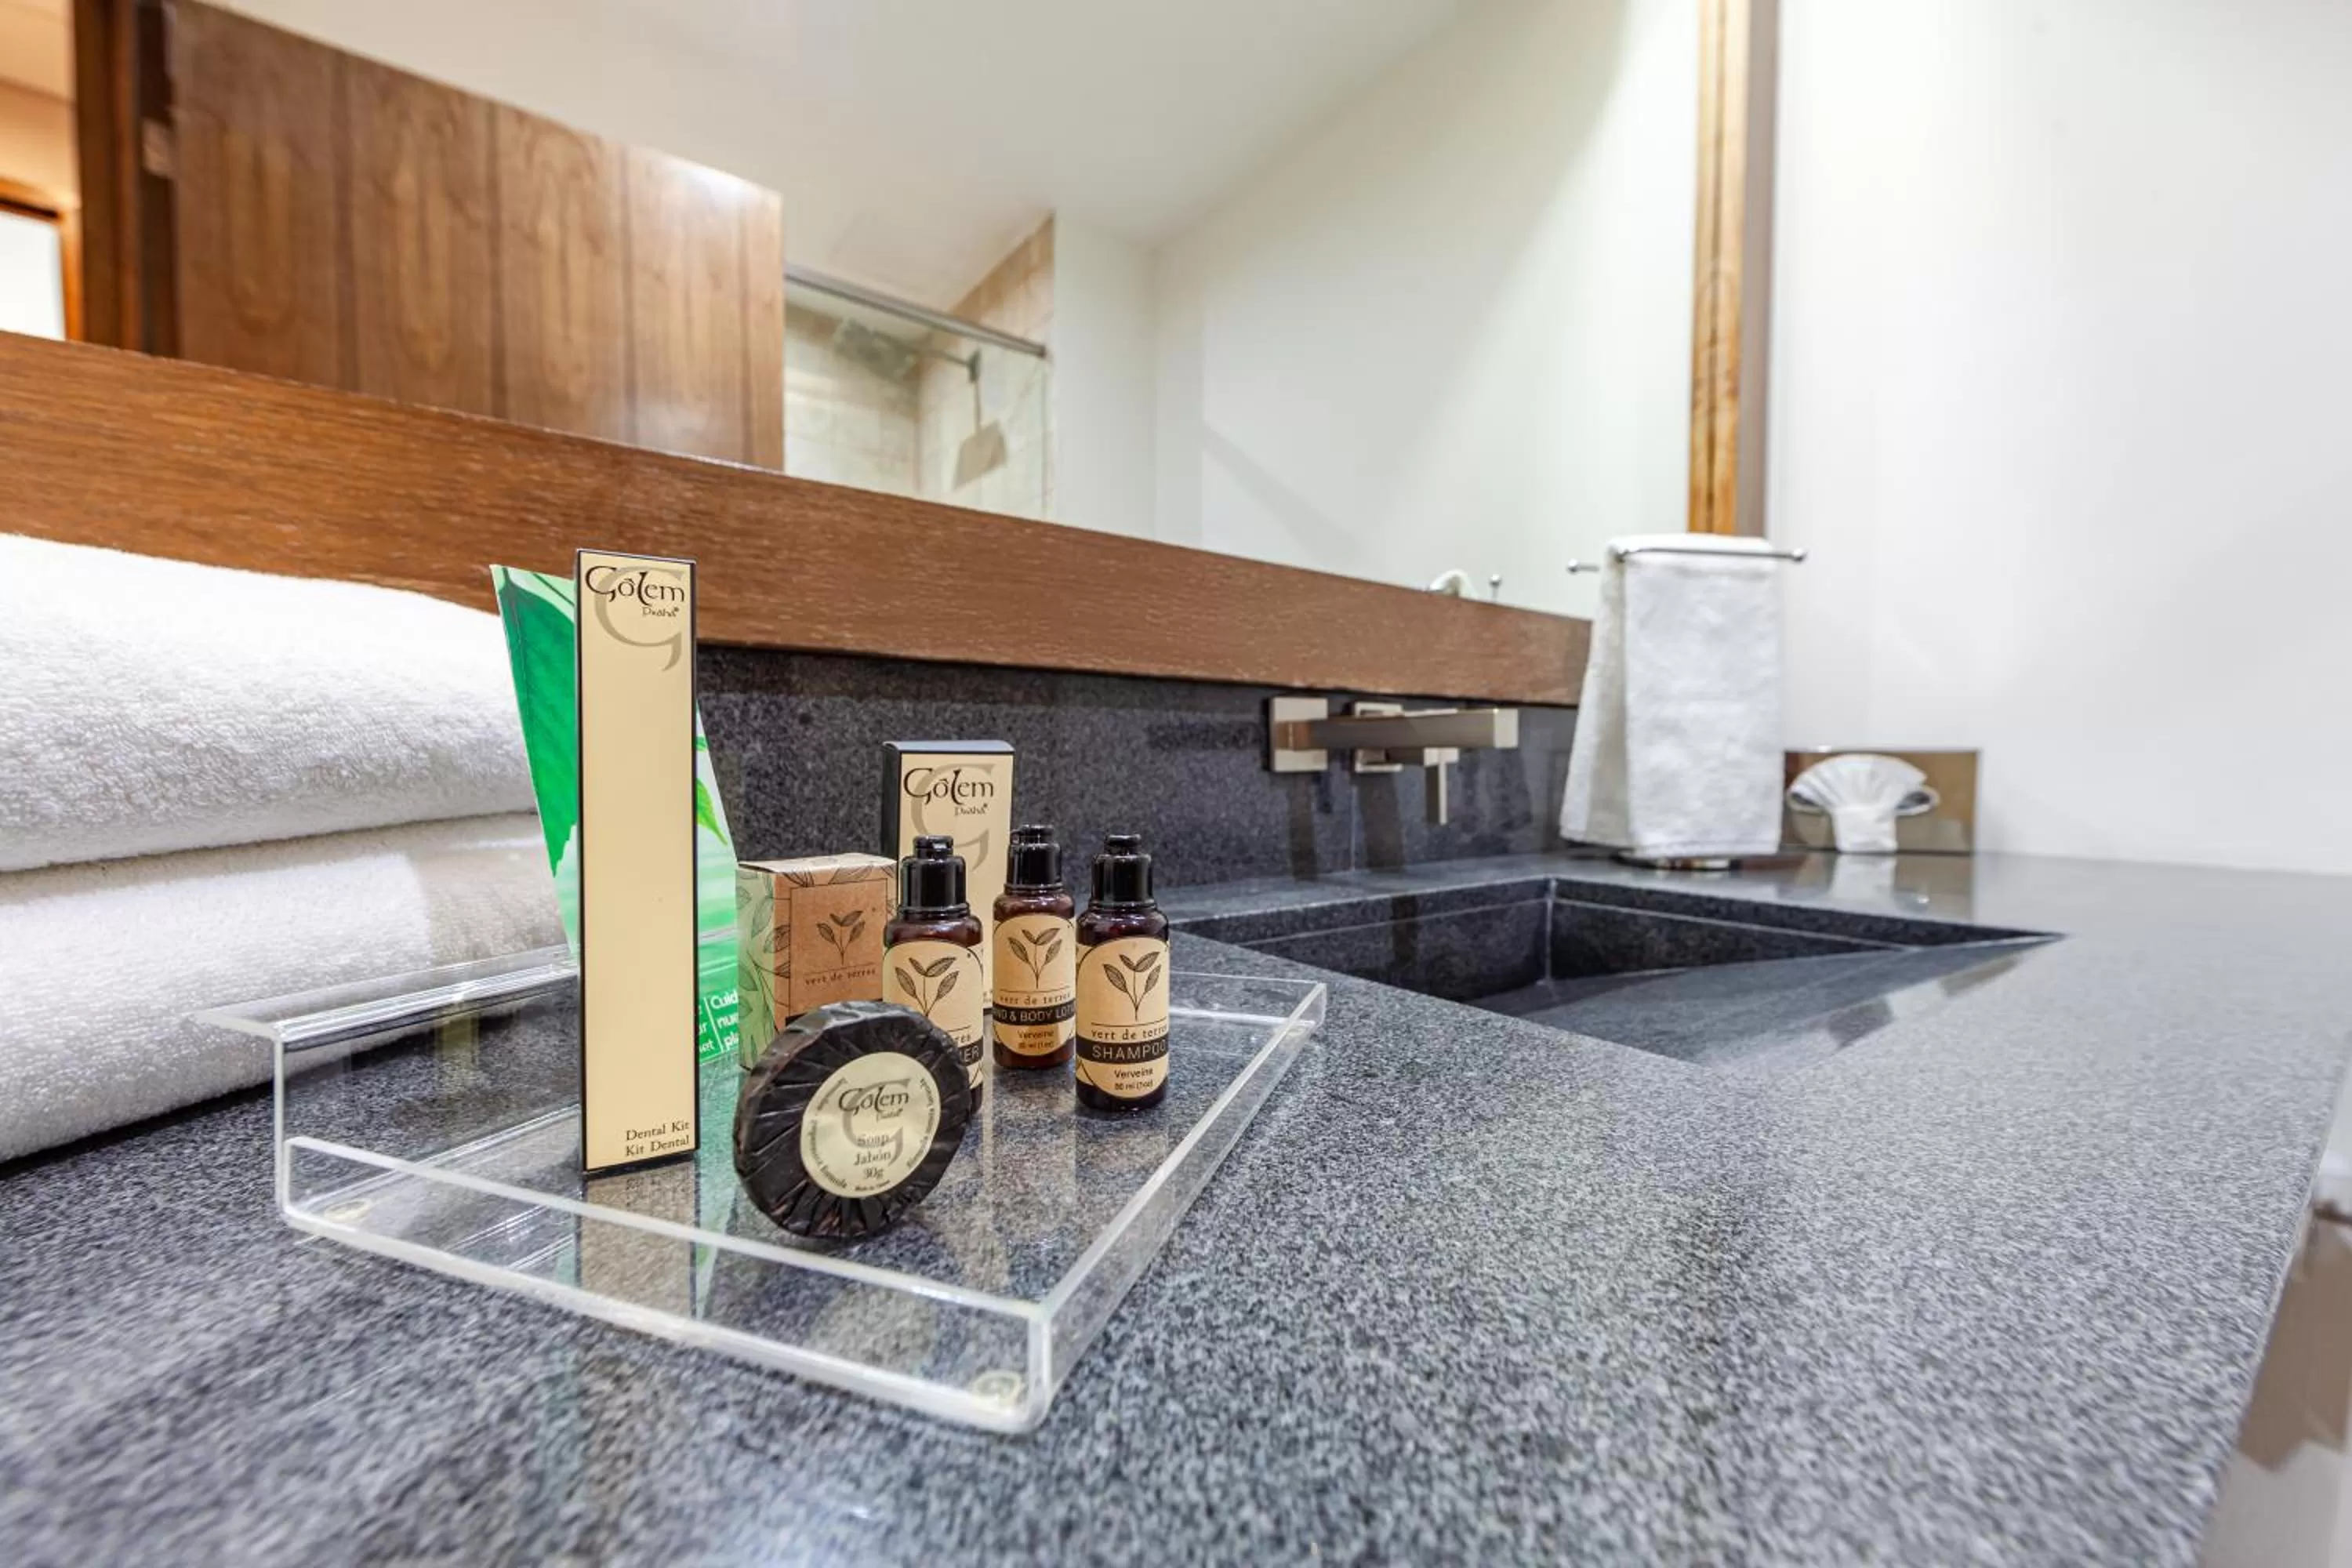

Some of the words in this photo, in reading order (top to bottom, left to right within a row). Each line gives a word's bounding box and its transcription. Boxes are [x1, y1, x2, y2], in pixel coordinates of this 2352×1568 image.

[1009, 1011, 1017, 1022] &
[1020, 1011, 1053, 1022] BODY
[1091, 1029, 1116, 1040] vert
[1122, 1028, 1137, 1040] de
[1091, 1039, 1166, 1060] SHAMPOO
[626, 1123, 666, 1142] Dental
[671, 1120, 691, 1133] Kit
[626, 1144, 644, 1156] Kit
[651, 1134, 689, 1152] Dental
